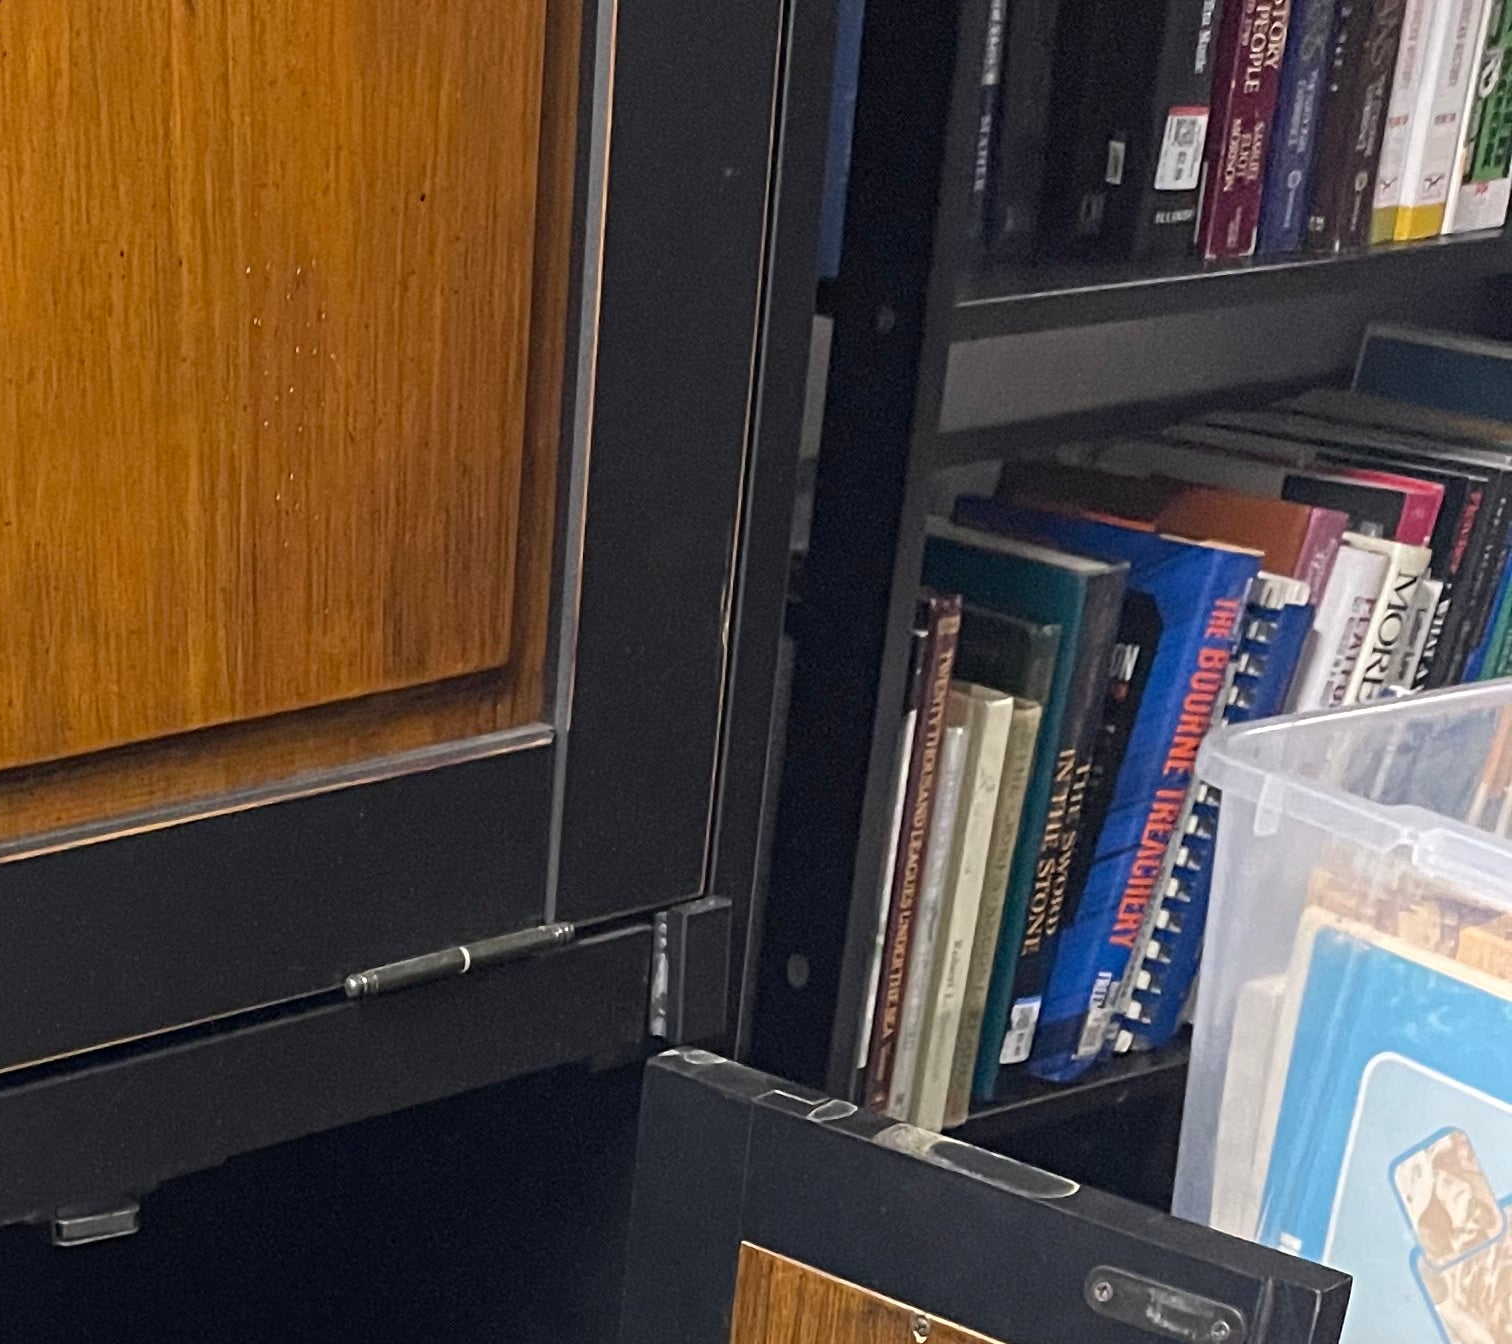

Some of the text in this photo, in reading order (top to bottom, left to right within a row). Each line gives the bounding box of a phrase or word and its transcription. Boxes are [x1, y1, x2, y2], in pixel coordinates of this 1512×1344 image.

[1161, 646, 1232, 776] BOURNE
[912, 728, 940, 828] THOUSAND
[900, 830, 925, 908] LEAGUES
[1020, 748, 1077, 957] IN THE STONE
[1044, 762, 1092, 936] THE SWORD
[891, 909, 913, 972] UNDER
